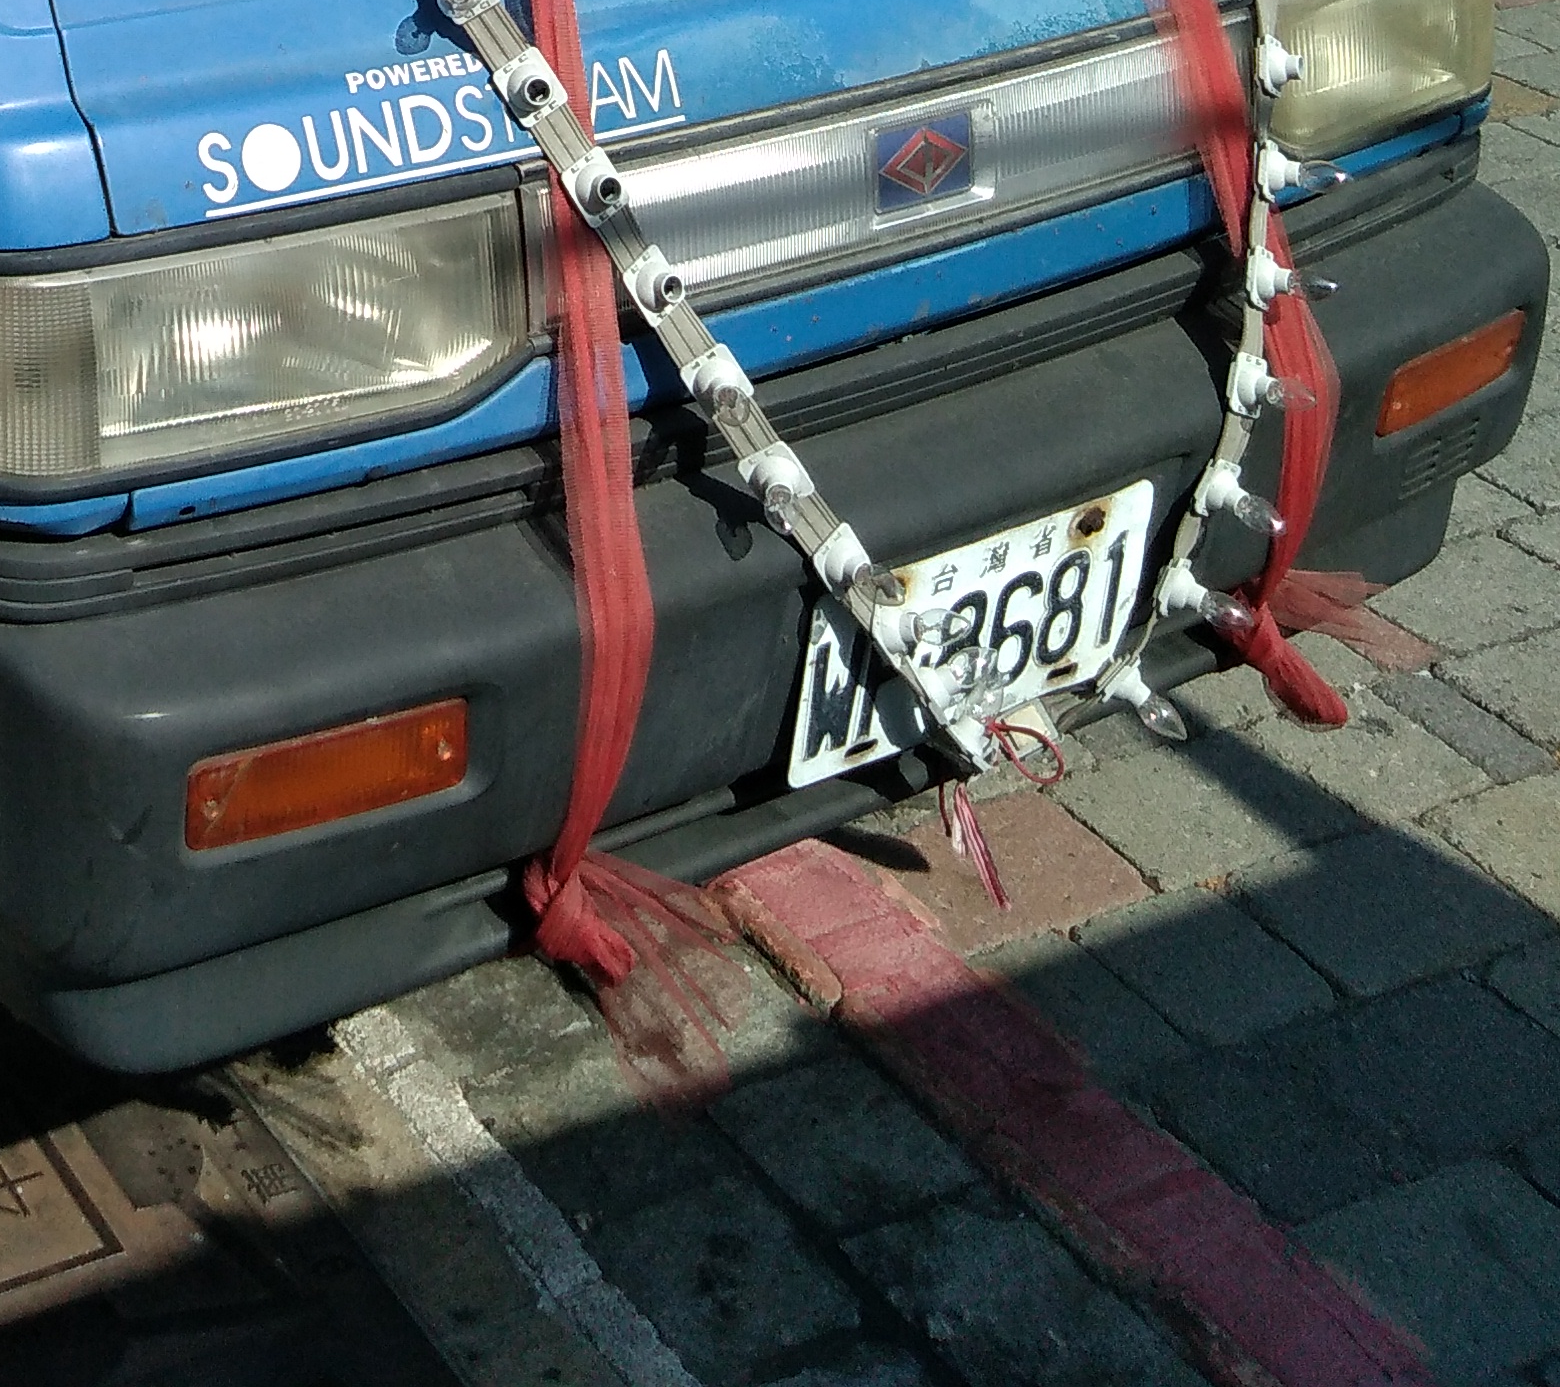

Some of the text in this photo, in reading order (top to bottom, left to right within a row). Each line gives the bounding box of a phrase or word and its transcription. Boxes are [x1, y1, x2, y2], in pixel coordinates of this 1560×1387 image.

[198, 49, 682, 204] SOUNDSAM
[931, 524, 1058, 597] 台灣省
